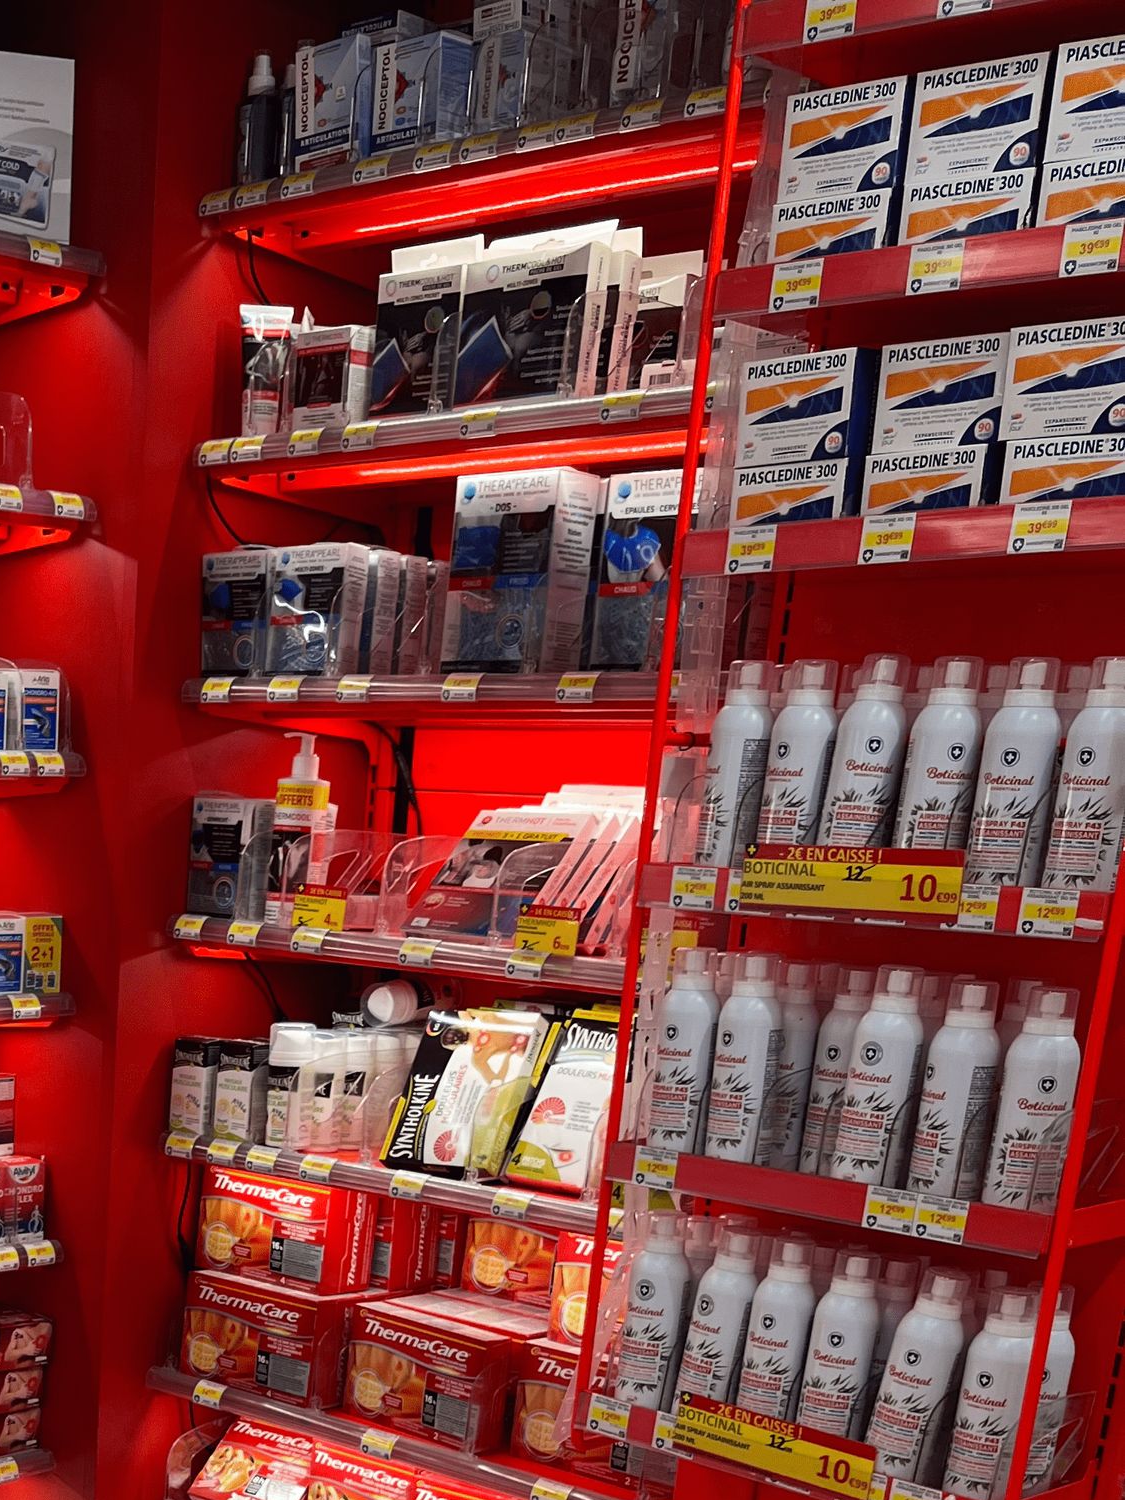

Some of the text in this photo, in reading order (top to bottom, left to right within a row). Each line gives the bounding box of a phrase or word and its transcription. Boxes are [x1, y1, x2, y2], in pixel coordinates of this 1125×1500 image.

[1014, 57, 1039, 77] 300
[300, 52, 310, 133] NOCICEPTOL
[377, 47, 391, 130] NOCICEPTOL
[874, 81, 897, 99] 300
[975, 337, 1000, 355] 300
[951, 450, 976, 466] 300
[846, 760, 894, 774] Boticinal
[786, 849, 874, 863] 2€ EN CAISSE
[743, 860, 816, 877] BOTICINAL
[214, 1173, 314, 1208] ThermaCare
[199, 1286, 302, 1323] ThermaCare
[364, 1319, 470, 1363] ThermaCare
[678, 1406, 742, 1436] BOTICINAL
